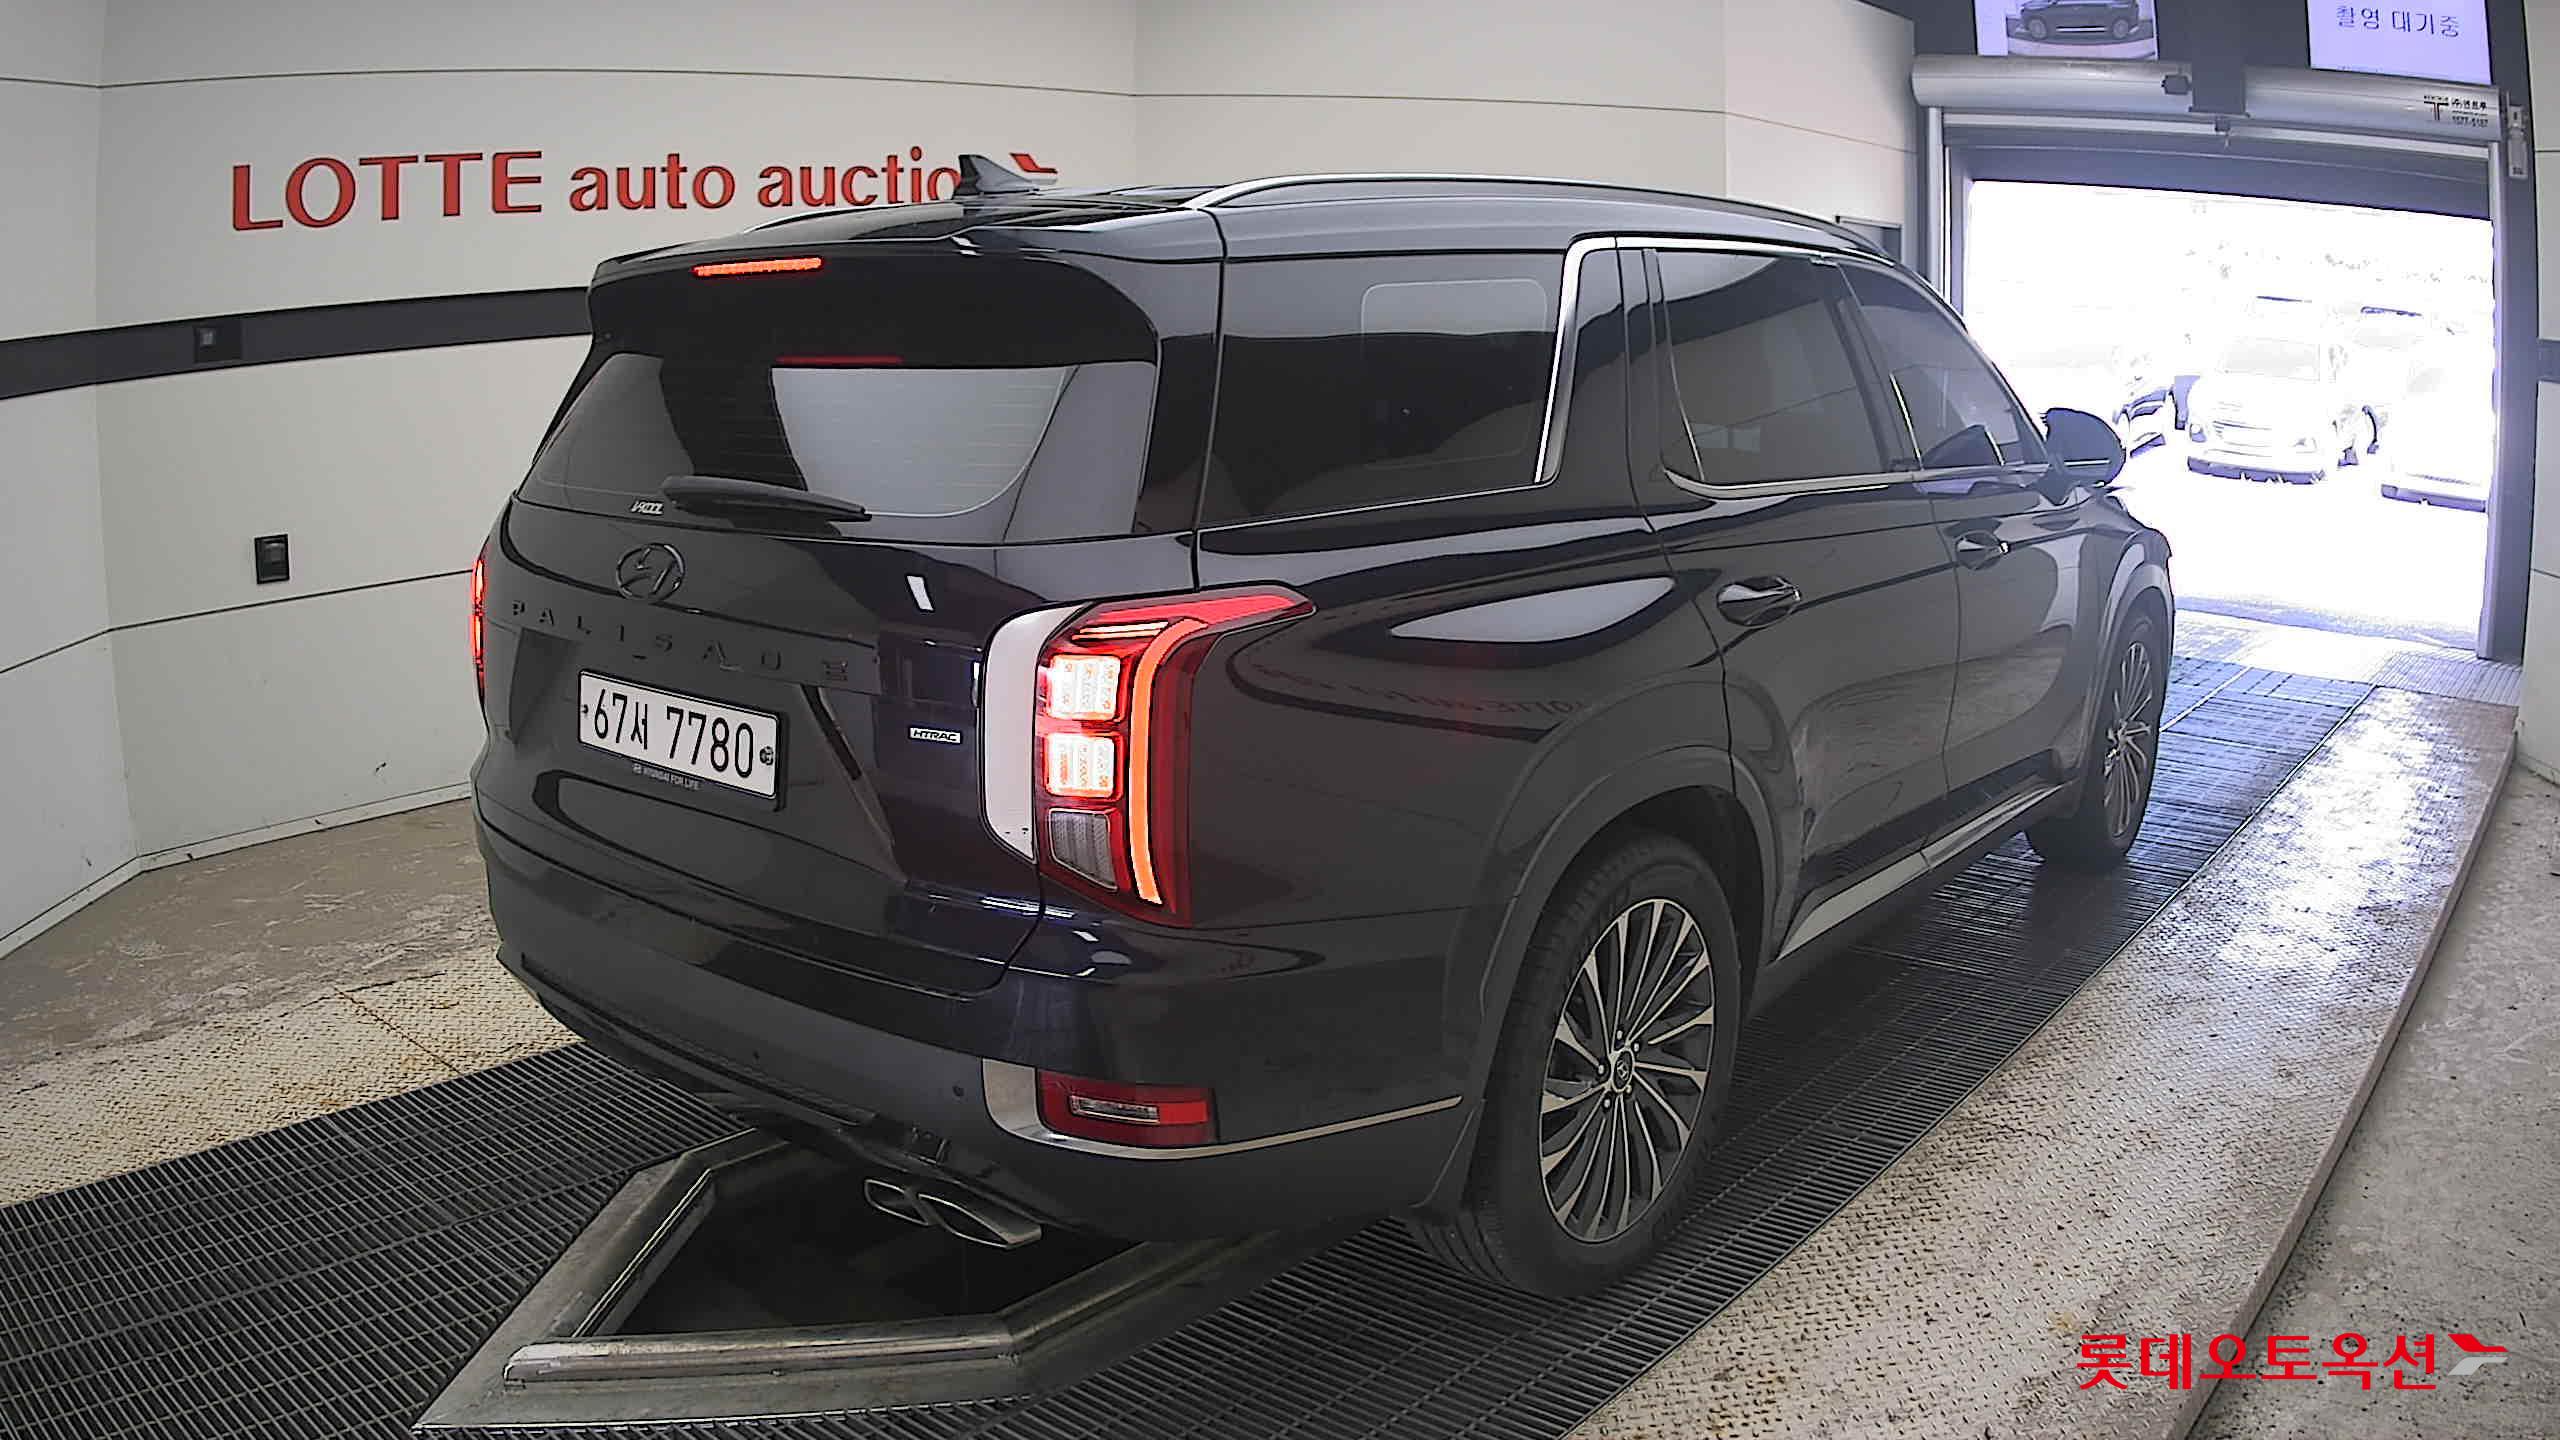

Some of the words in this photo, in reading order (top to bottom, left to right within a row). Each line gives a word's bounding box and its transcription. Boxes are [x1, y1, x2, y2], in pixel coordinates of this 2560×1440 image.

[2391, 11, 2459, 38] 대기중
[233, 150, 543, 232] LOTTE
[569, 153, 736, 211] auto
[757, 145, 962, 208] auctio
[512, 599, 850, 682] PALISADE
[594, 688, 649, 750] 67서
[666, 705, 754, 778] 7780
[911, 728, 960, 743] HTRAC
